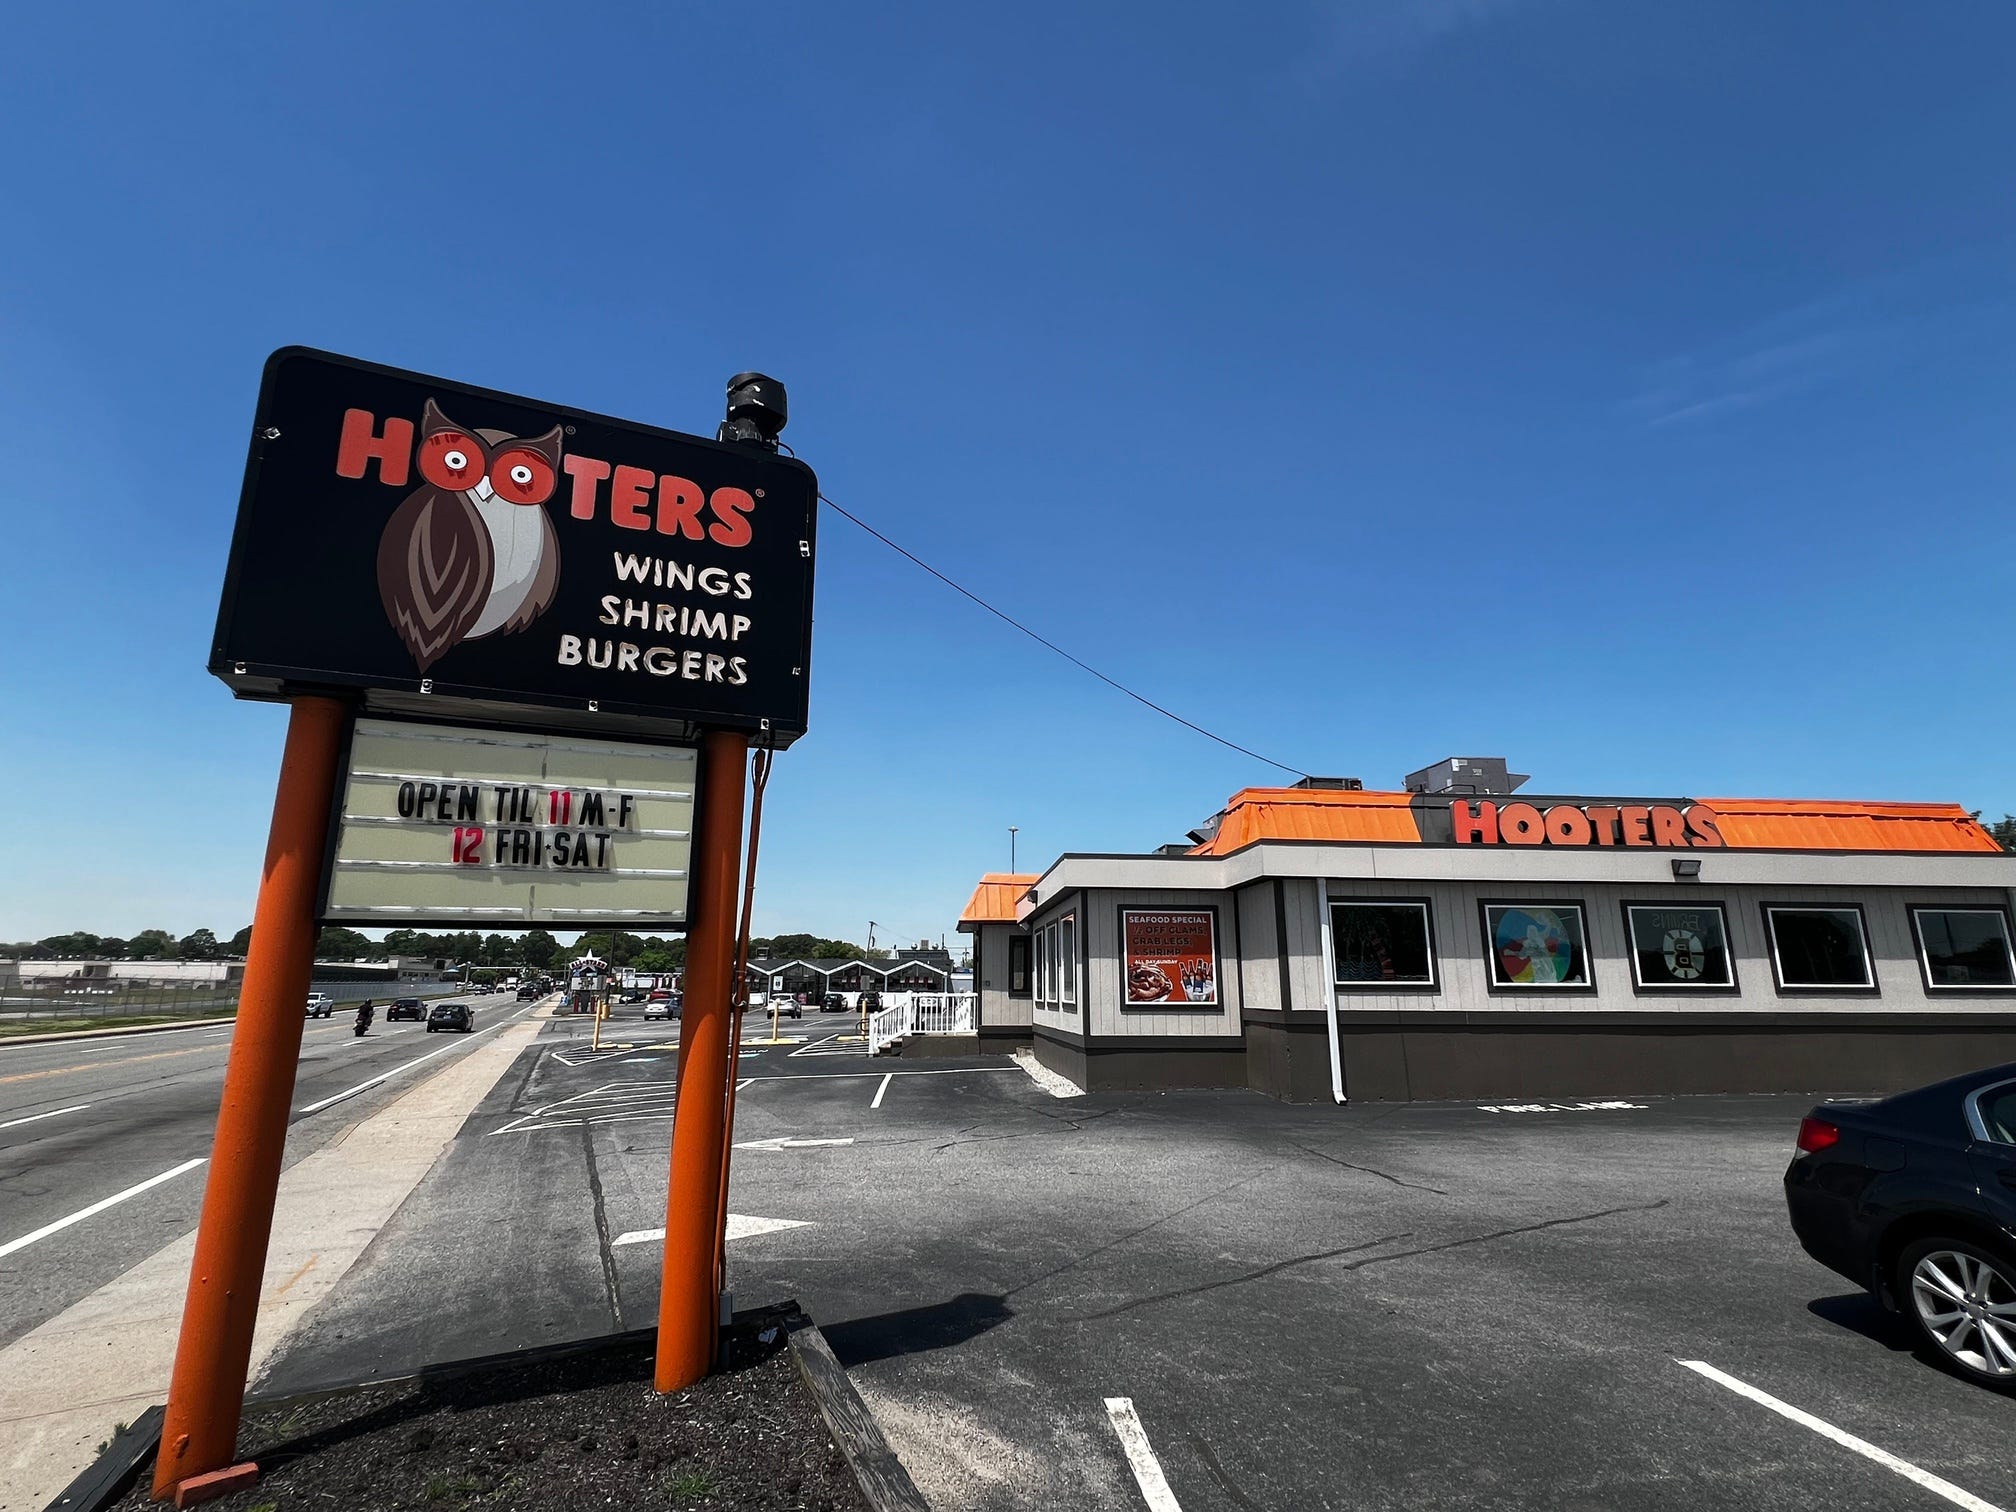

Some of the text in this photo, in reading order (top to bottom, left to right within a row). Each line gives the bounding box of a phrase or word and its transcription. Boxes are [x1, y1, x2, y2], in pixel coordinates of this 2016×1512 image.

[336, 407, 756, 548] HOOTERS
[613, 551, 753, 600] WINGS
[598, 595, 752, 641] SHRIMP
[557, 634, 748, 686] BURGERS
[397, 781, 634, 828] OPEN TIL 11 M-F
[1452, 799, 1722, 847] HOOTERS
[452, 826, 485, 864] 12
[1132, 937, 1161, 946] CRAB
[1143, 948, 1181, 956] SHRIMP
[1145, 926, 1166, 935] OFF
